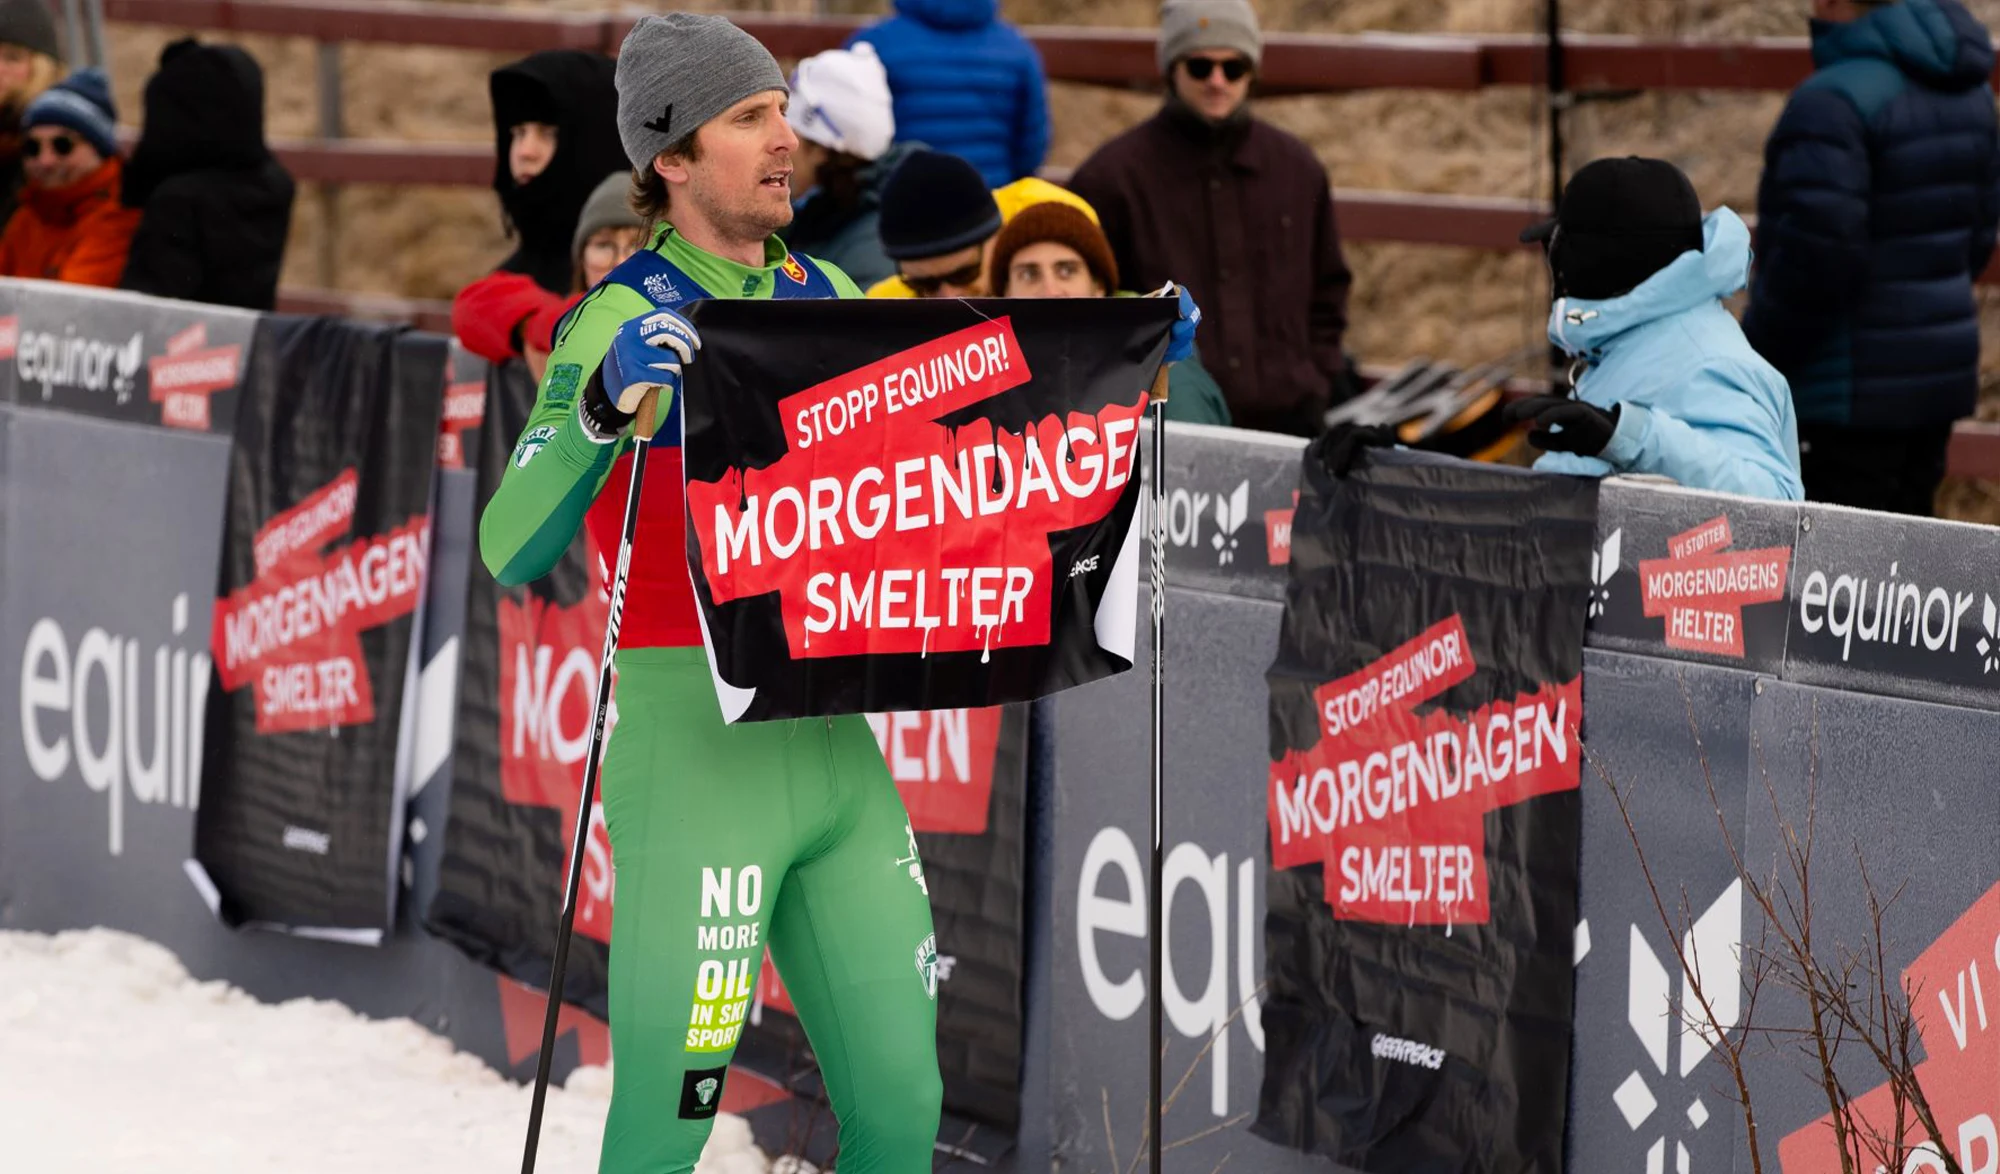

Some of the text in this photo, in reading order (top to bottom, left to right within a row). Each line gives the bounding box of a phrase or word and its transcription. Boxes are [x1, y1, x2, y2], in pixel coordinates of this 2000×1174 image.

[17, 323, 118, 401] equinor
[783, 333, 1010, 449] STOPP EQUINOR!
[713, 415, 1139, 575] MORGENDAGE
[1674, 523, 1727, 561] VI STØTTER
[803, 566, 1034, 634] SMELTER
[1647, 561, 1779, 600] MORGENDAGENS
[1800, 560, 1974, 661] equinor
[1671, 606, 1735, 645] HELTER
[1324, 630, 1463, 738] STOPP EQUINOR!
[1275, 697, 1568, 845] MORGENDAGEN
[701, 864, 762, 918] NO
[1340, 845, 1476, 905] SMELTER
[697, 922, 759, 951] MORE
[697, 957, 750, 1001] OIL
[1938, 958, 1987, 1052] VI
[686, 1023, 741, 1048] SPORT
[690, 999, 748, 1026] IN SKI
